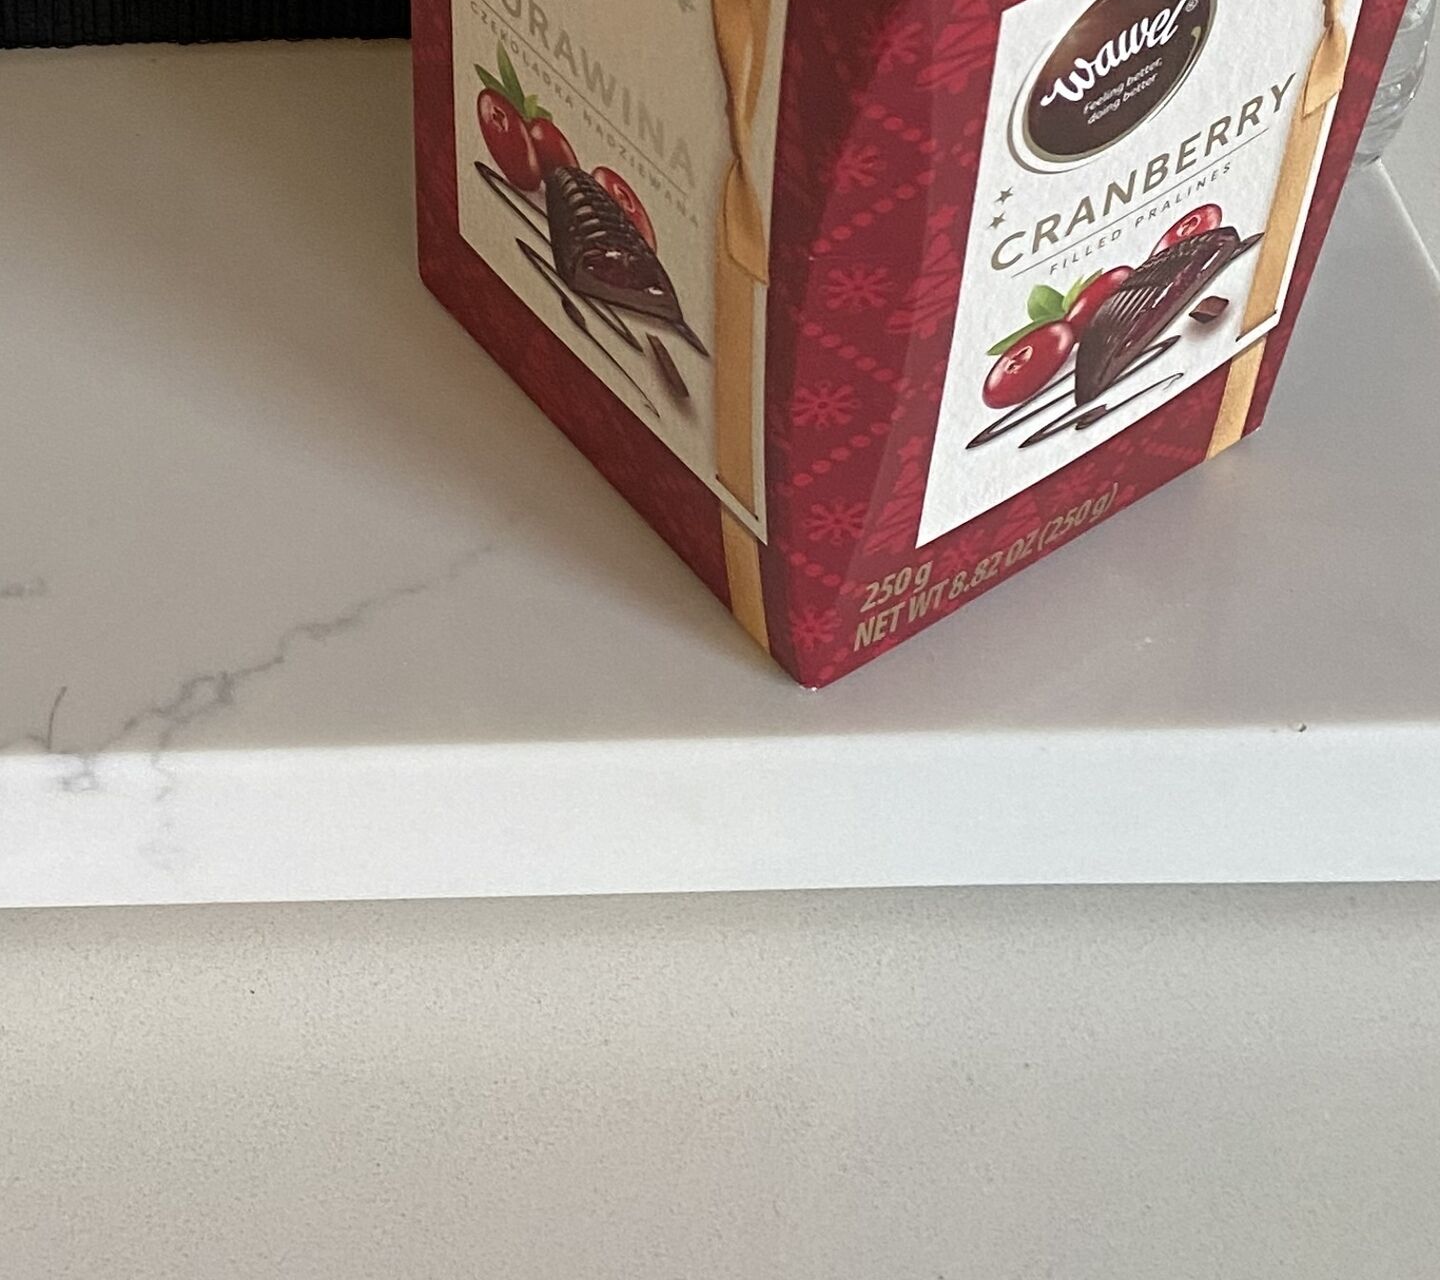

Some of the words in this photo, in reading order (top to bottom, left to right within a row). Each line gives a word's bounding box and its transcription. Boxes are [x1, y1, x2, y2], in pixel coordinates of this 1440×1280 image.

[1088, 98, 1121, 125] doing
[1123, 73, 1158, 102] better
[990, 72, 1296, 271] CRANBERRY
[1049, 228, 1121, 276] FILLED
[1135, 161, 1232, 229] PRALINES
[853, 601, 906, 653] NET
[908, 578, 950, 624] WT
[1005, 527, 1040, 567] OZ
[860, 566, 912, 614] 250
[913, 560, 934, 594] g
